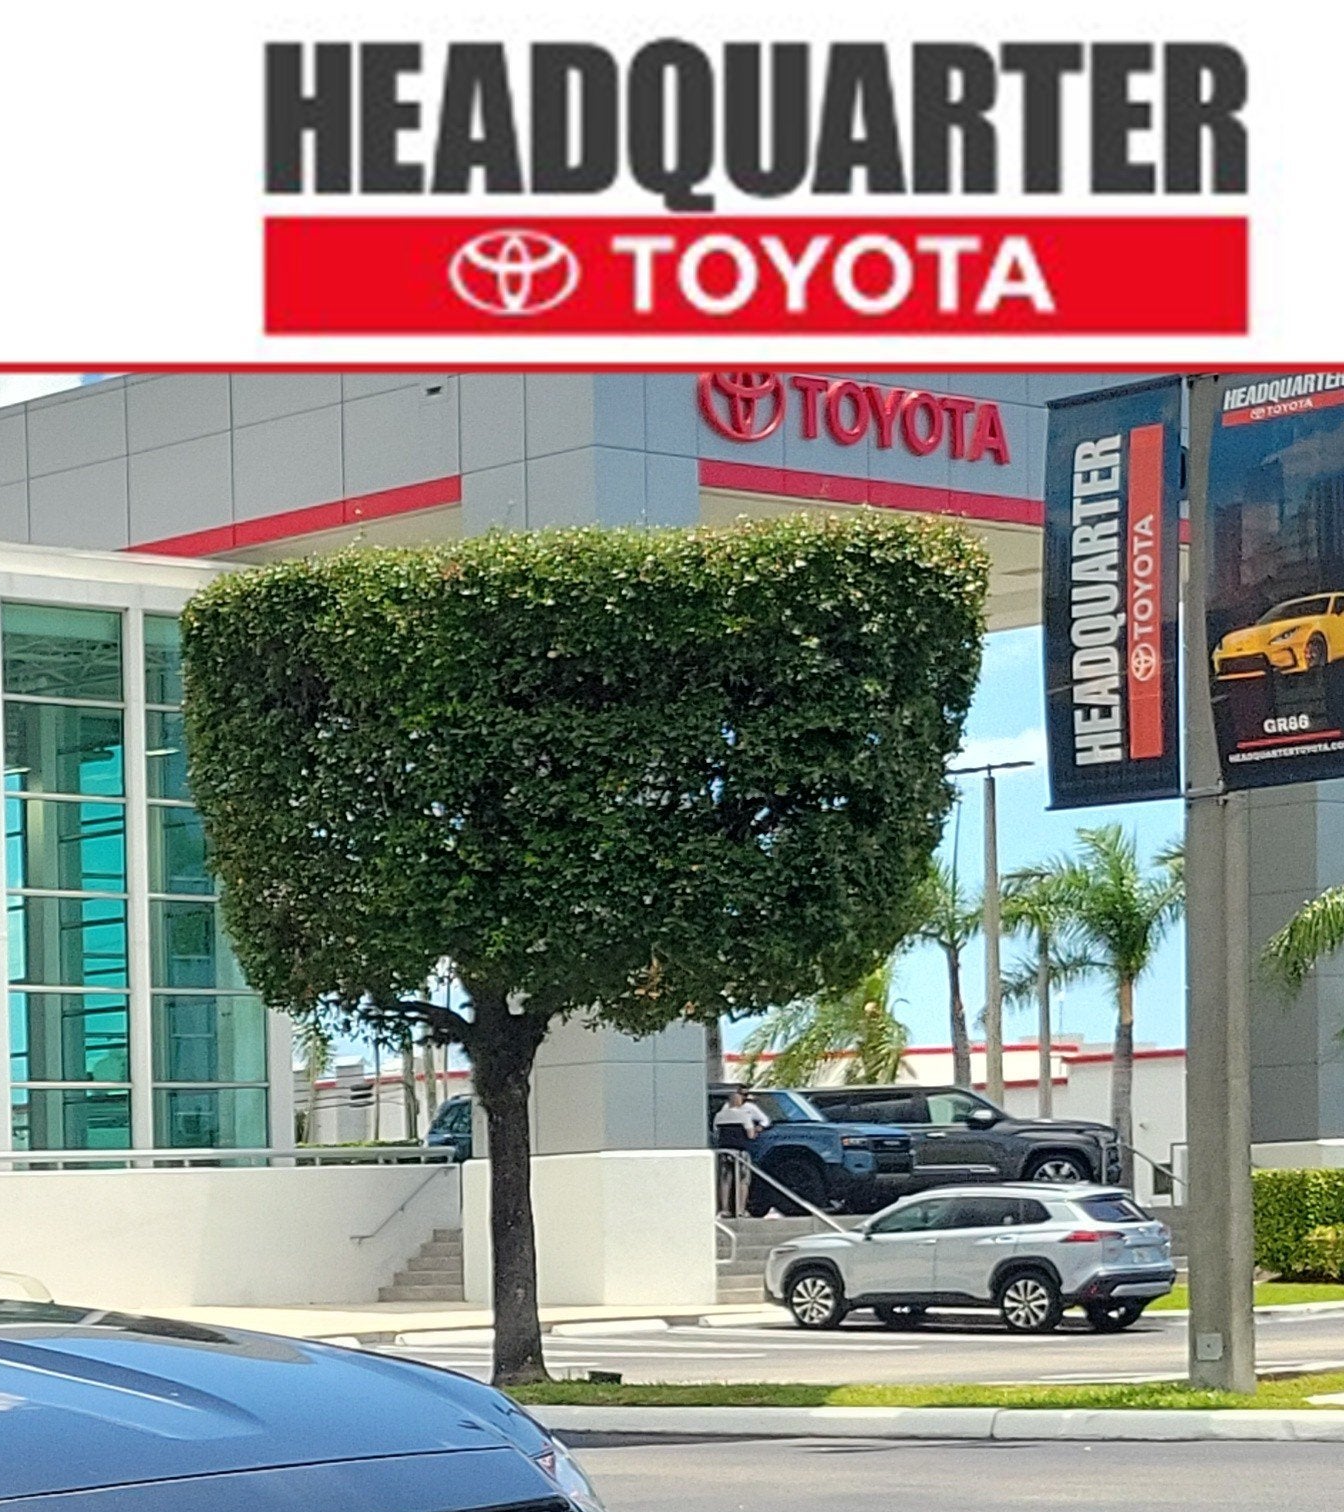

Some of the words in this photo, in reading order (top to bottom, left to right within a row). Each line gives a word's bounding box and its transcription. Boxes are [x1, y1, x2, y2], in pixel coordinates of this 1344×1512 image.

[789, 375, 1010, 466] TOYOTA
[1267, 398, 1314, 416] TOYOTA
[1070, 433, 1126, 767] HEADQUARTER
[1133, 514, 1155, 641] TOYOTA
[1262, 713, 1310, 734] GR86
